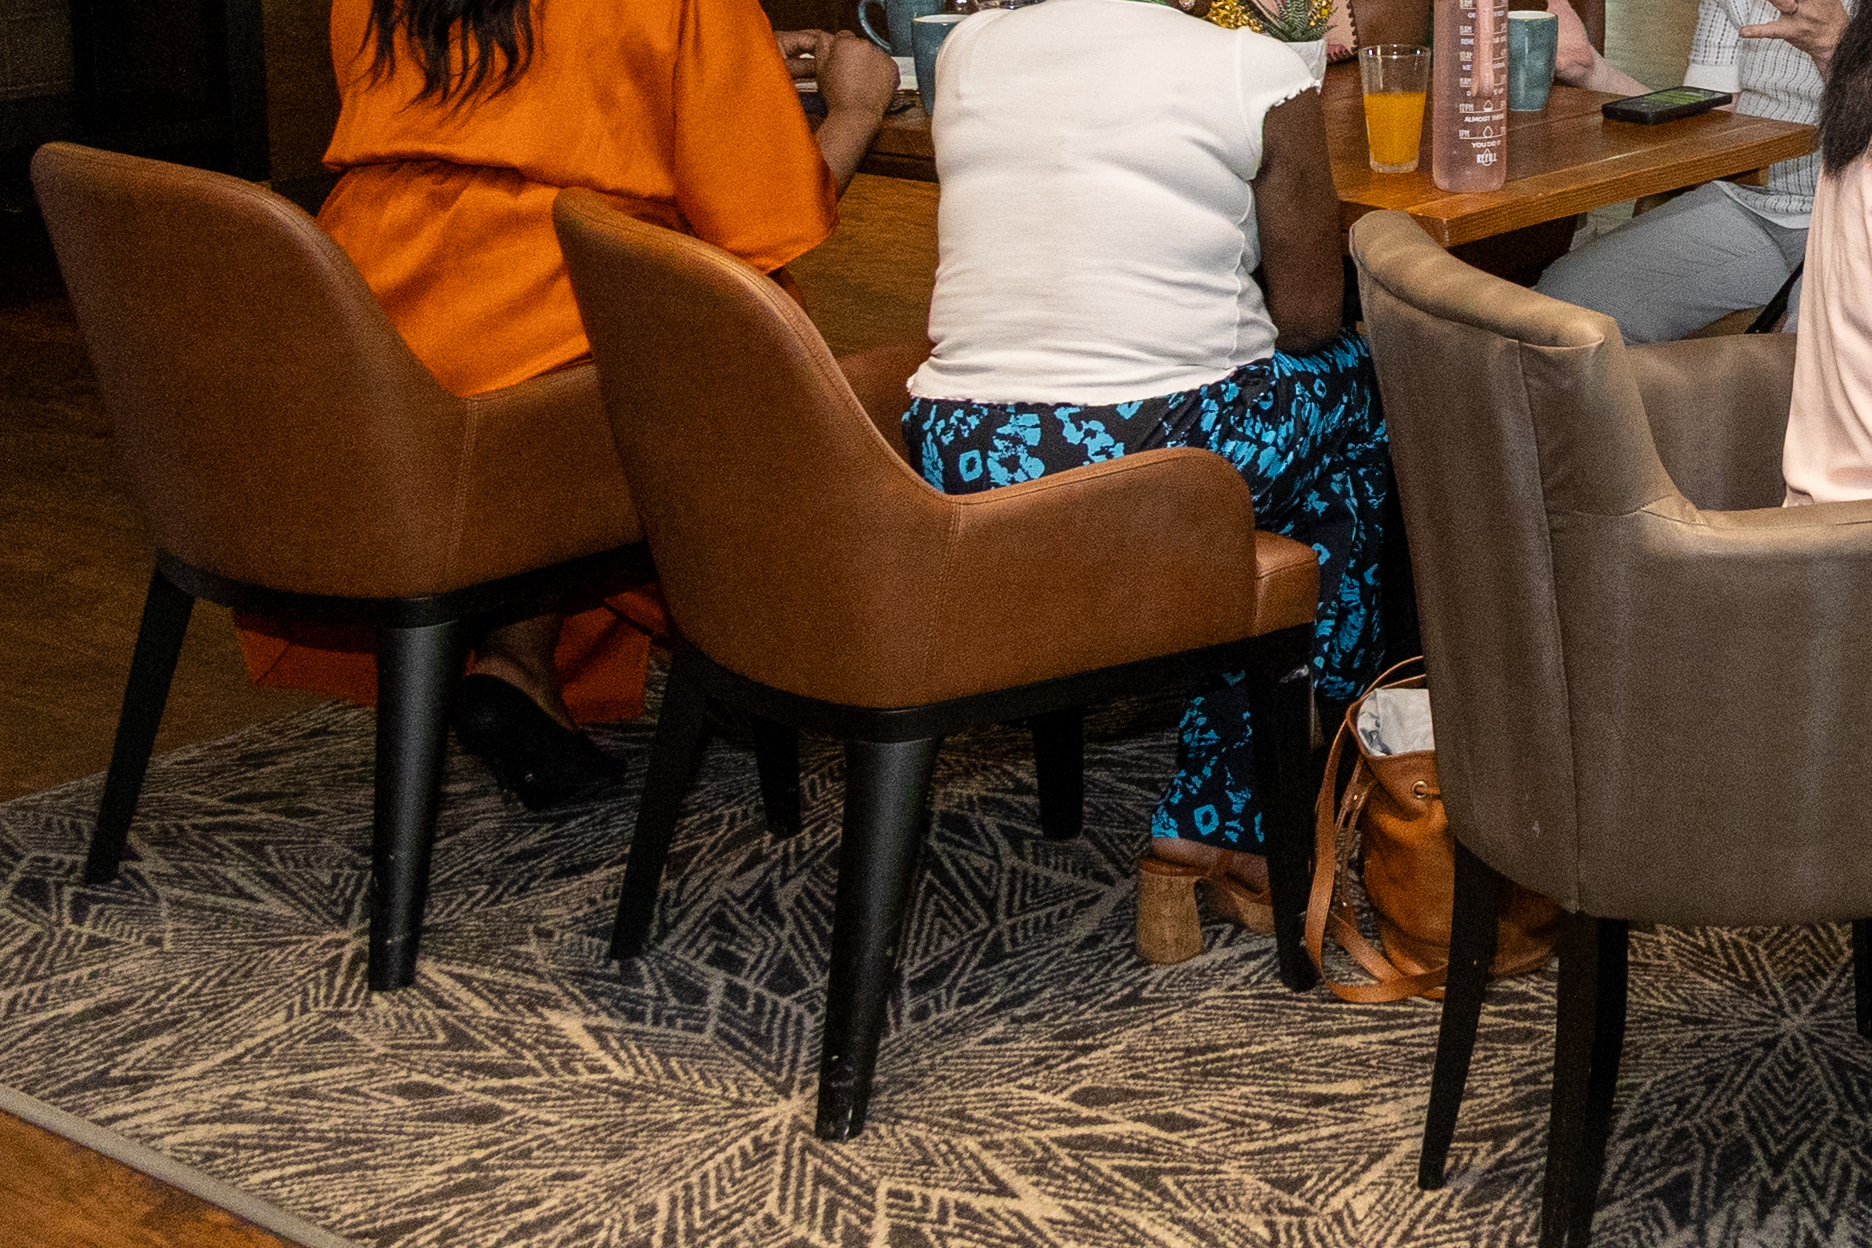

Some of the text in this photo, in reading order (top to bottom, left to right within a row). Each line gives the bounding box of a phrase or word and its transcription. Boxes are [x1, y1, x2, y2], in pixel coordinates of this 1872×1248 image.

[1464, 115, 1491, 123] ALMOST
[1471, 141, 1487, 149] YOU
[1476, 152, 1498, 164] REFILL
